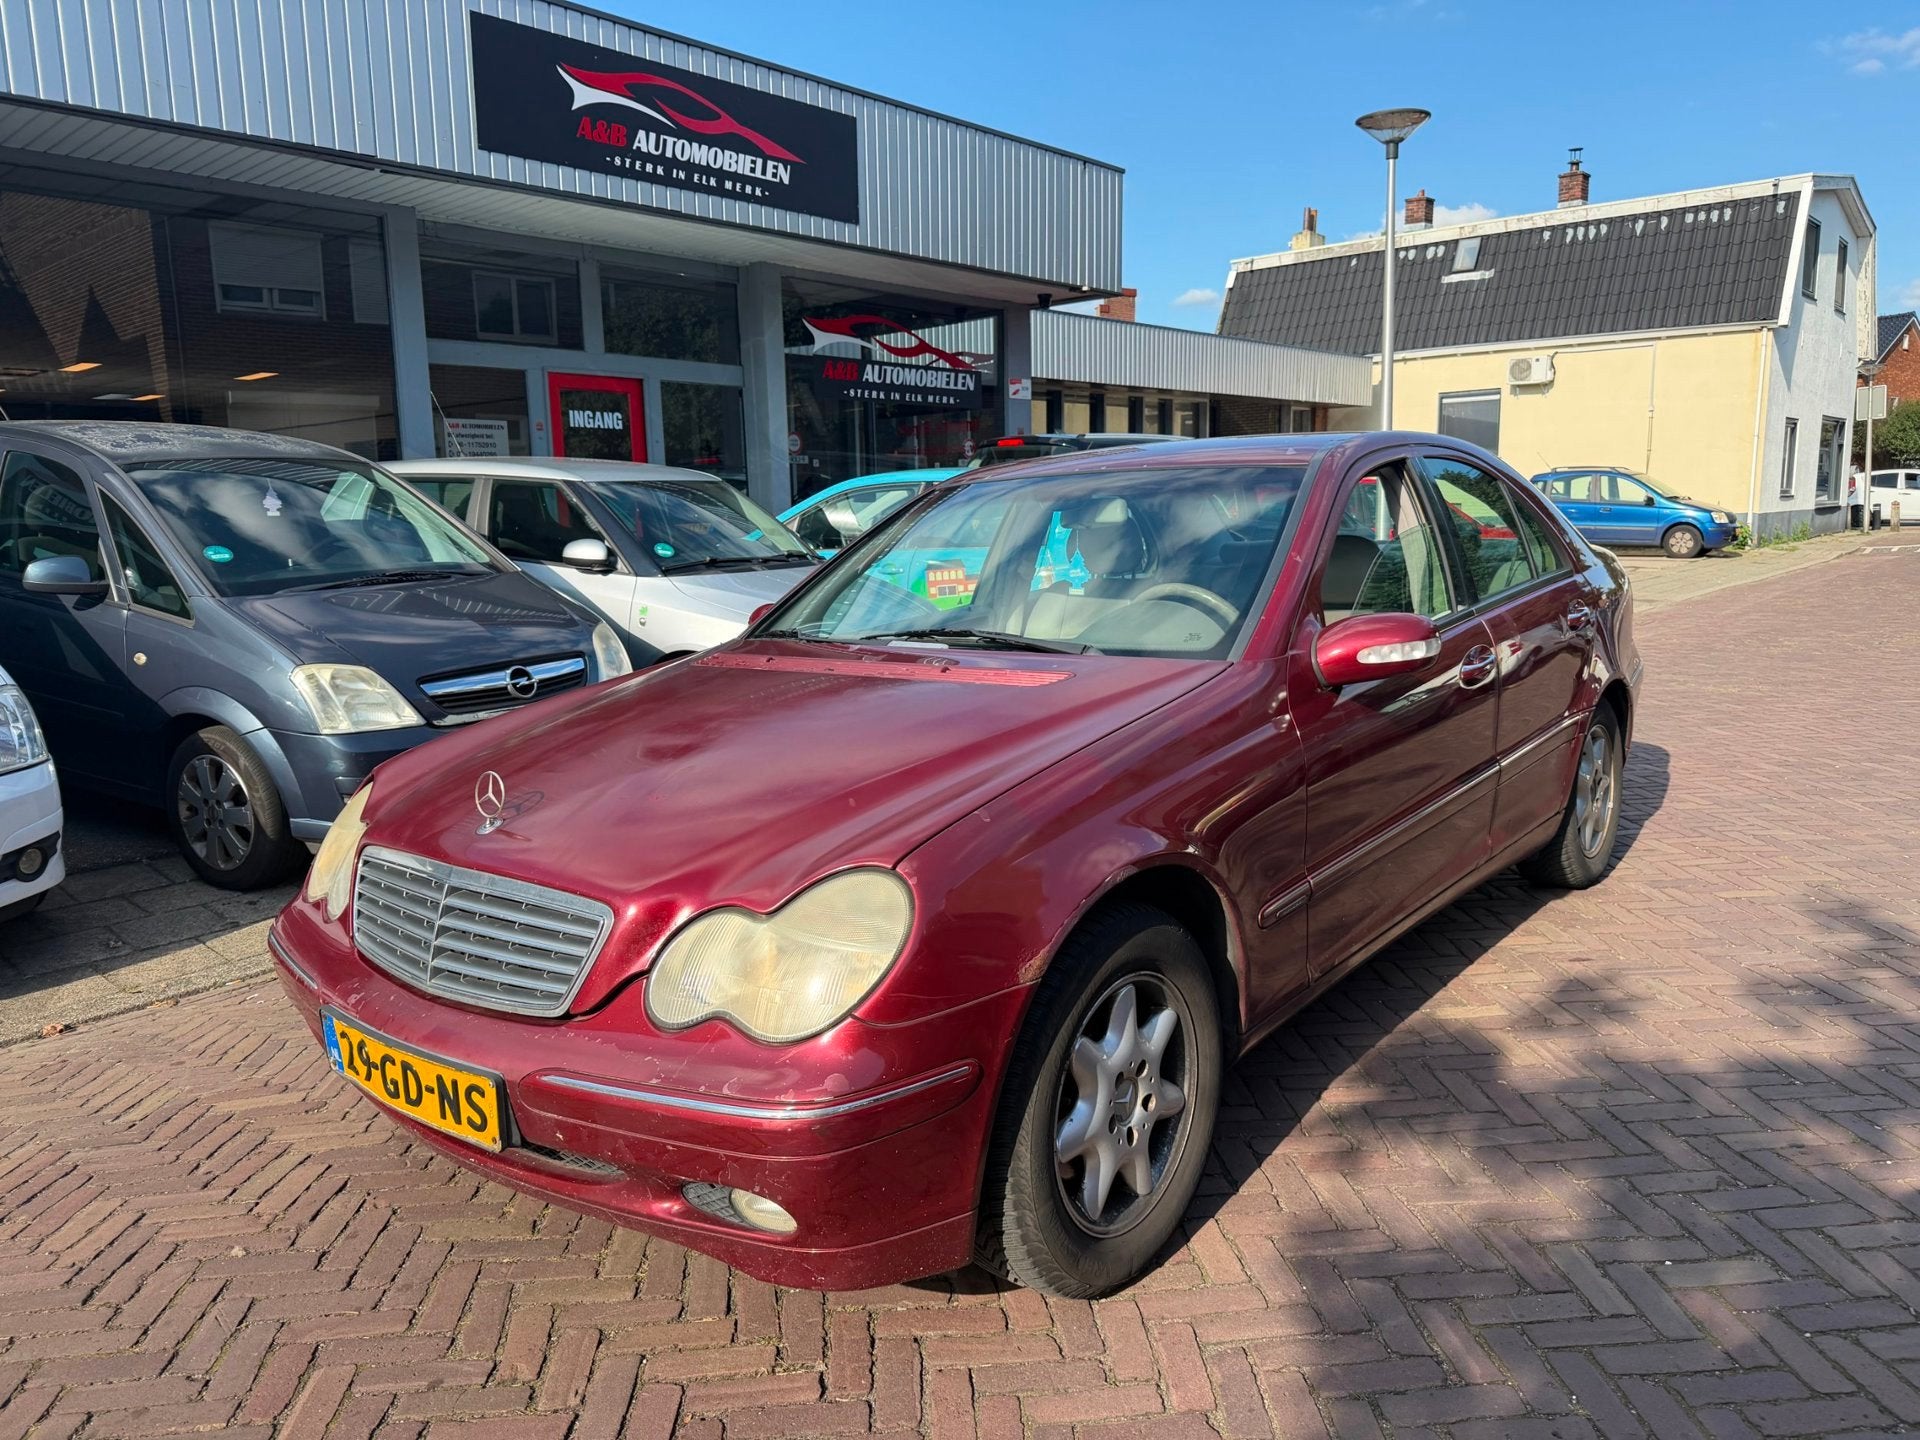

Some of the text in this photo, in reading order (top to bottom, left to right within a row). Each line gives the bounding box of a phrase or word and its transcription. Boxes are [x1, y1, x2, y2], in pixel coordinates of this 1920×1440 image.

[576, 116, 791, 185] A&B AUTOMOBIELEN
[672, 168, 686, 180] IN
[693, 173, 718, 187] ELK
[822, 360, 976, 391] A&B AUTOMOBIELEN
[890, 391, 901, 400] IN
[905, 393, 923, 402] ELK
[568, 409, 623, 430] INGANG
[339, 1030, 488, 1133] 29-GD-NS
